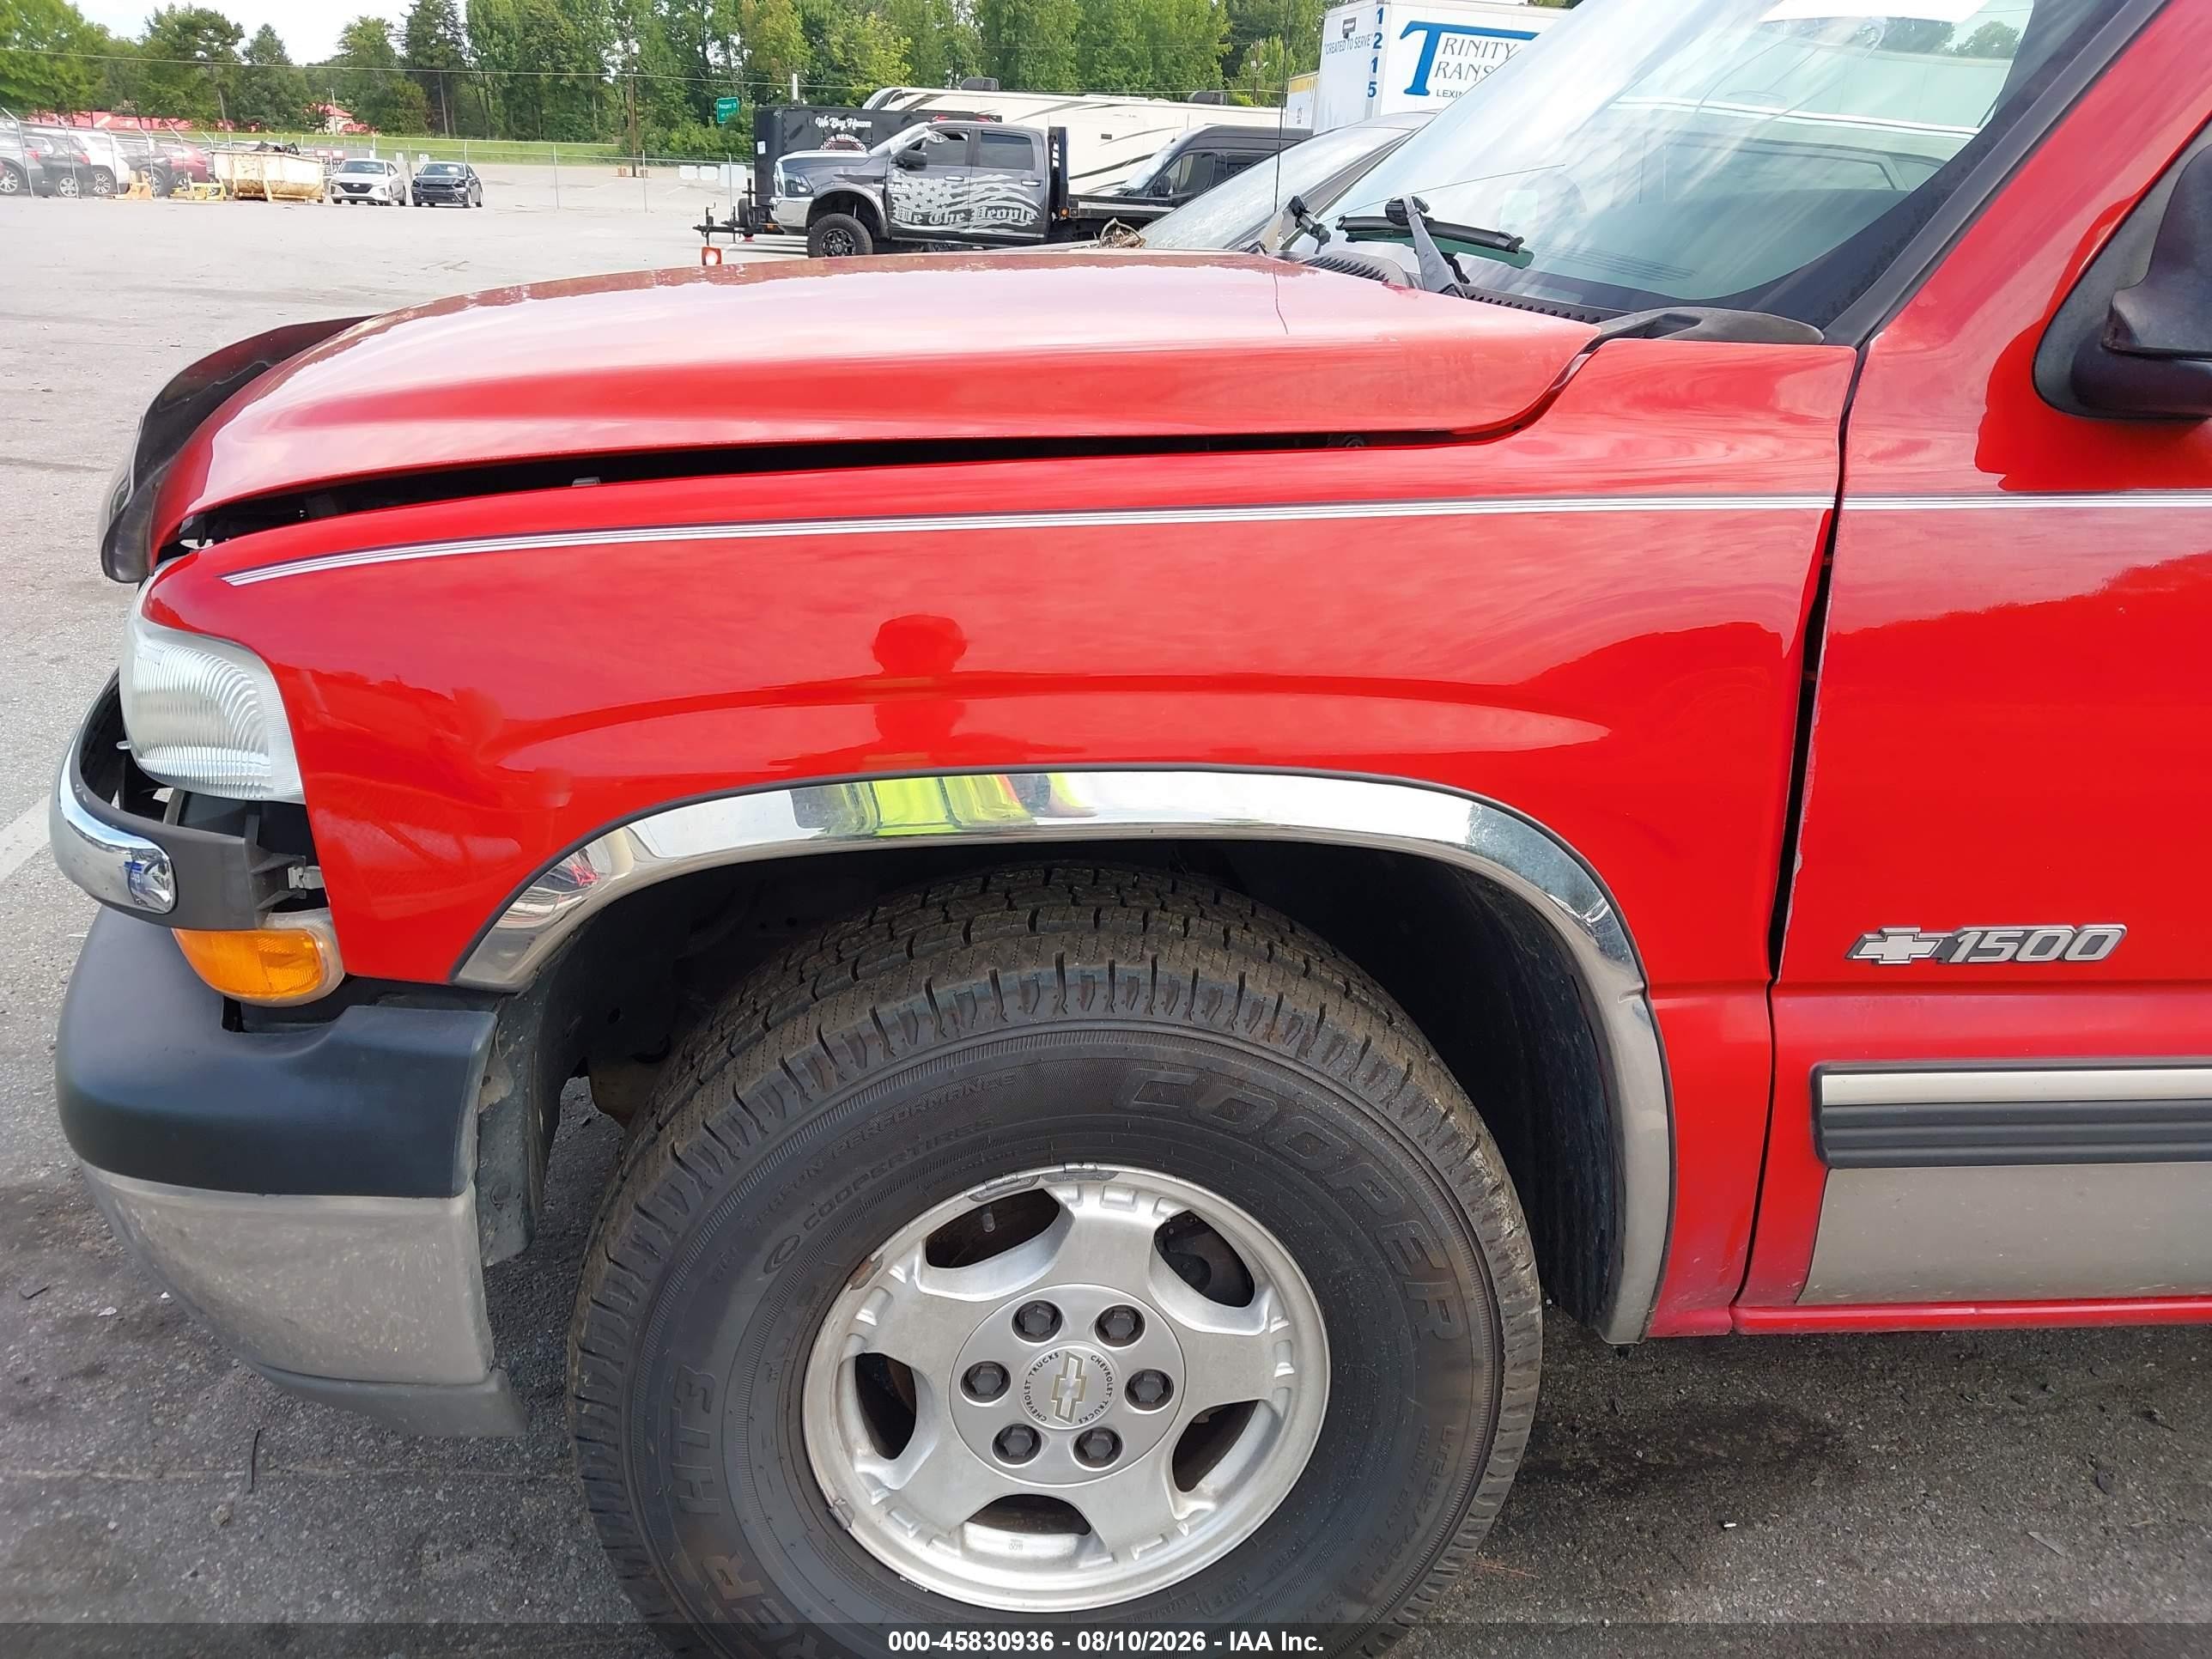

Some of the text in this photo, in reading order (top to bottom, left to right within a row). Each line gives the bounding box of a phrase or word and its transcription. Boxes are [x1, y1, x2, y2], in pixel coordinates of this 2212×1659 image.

[1347, 38, 1353, 50] TO
[1948, 929, 2125, 963] 1500
[1117, 1067, 1461, 1340] COOPER
[1024, 1352, 1059, 1422] CHEVROLET TRUCKS
[1078, 1355, 1114, 1425] CHEVROLET TRUCKS
